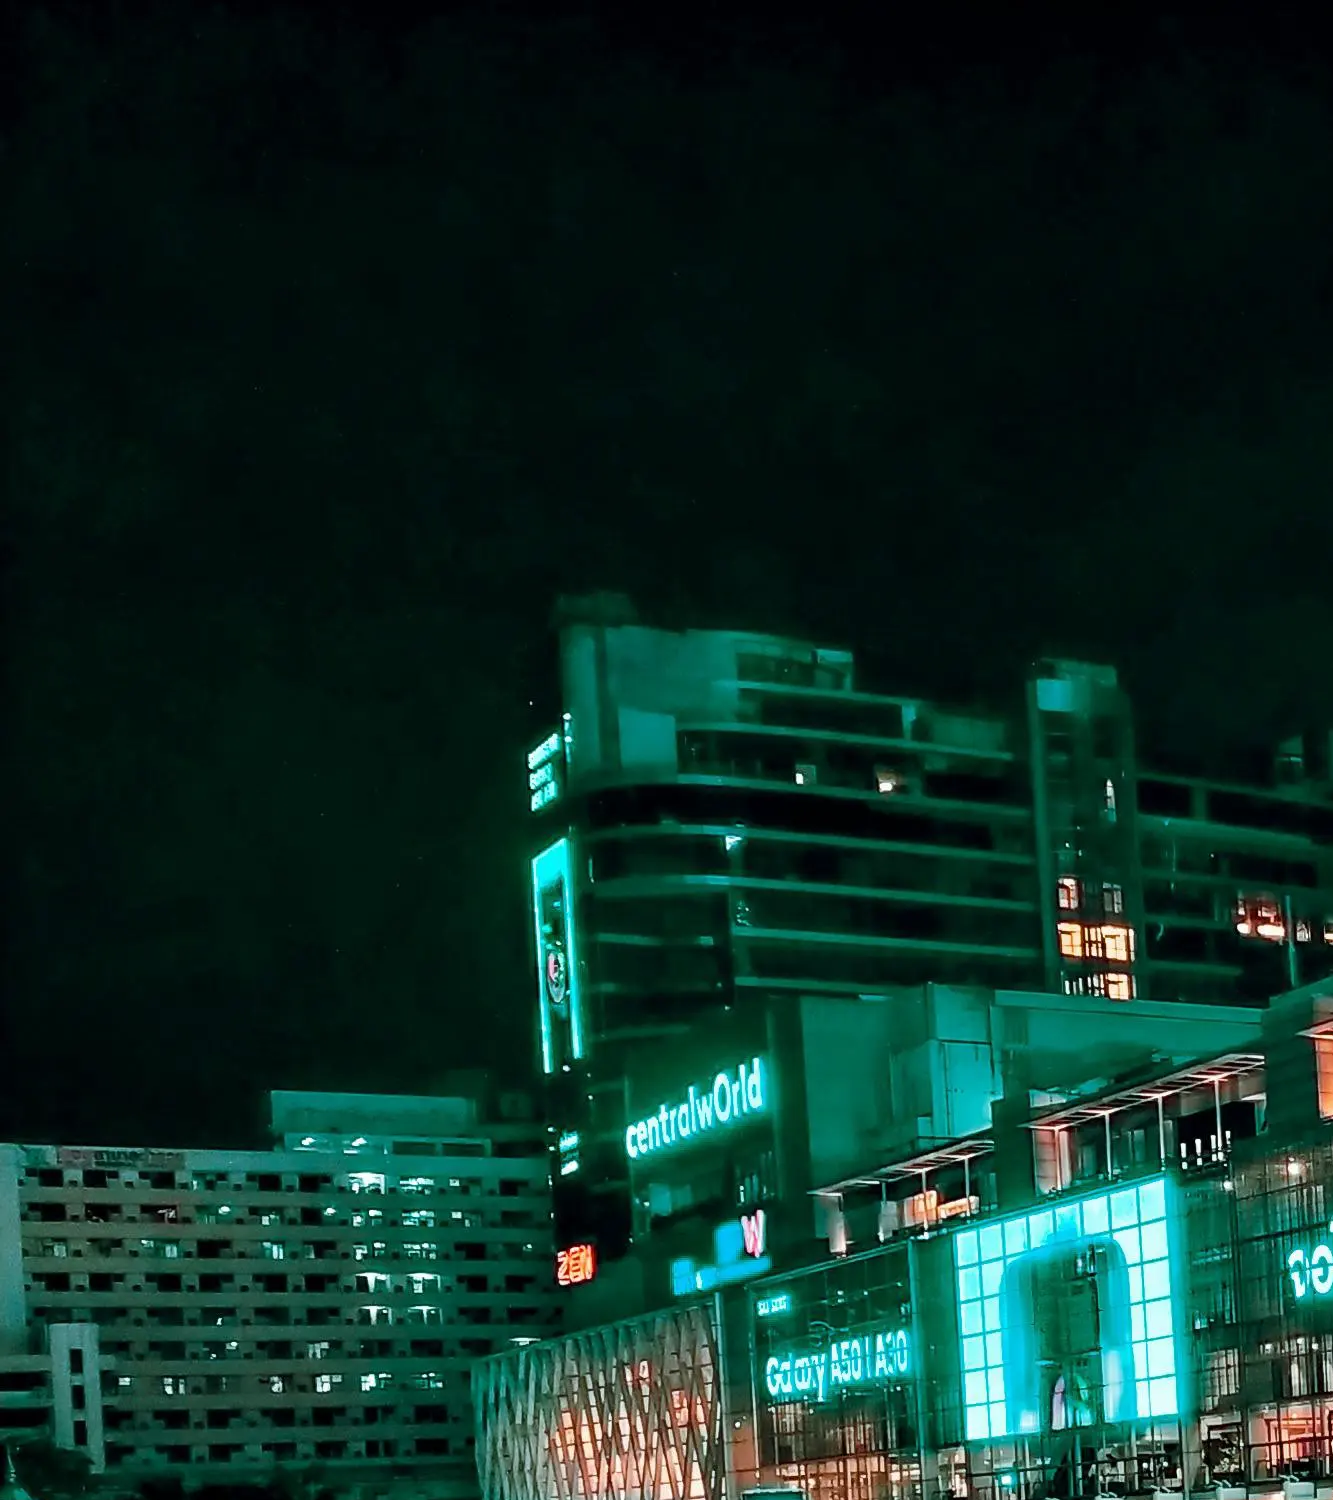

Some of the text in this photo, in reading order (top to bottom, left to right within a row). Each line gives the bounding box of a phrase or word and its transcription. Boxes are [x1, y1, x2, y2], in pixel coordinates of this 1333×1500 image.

[625, 1057, 764, 1159] centralwOrld
[766, 1353, 827, 1402] Galaxy
[830, 1338, 862, 1384] A50
